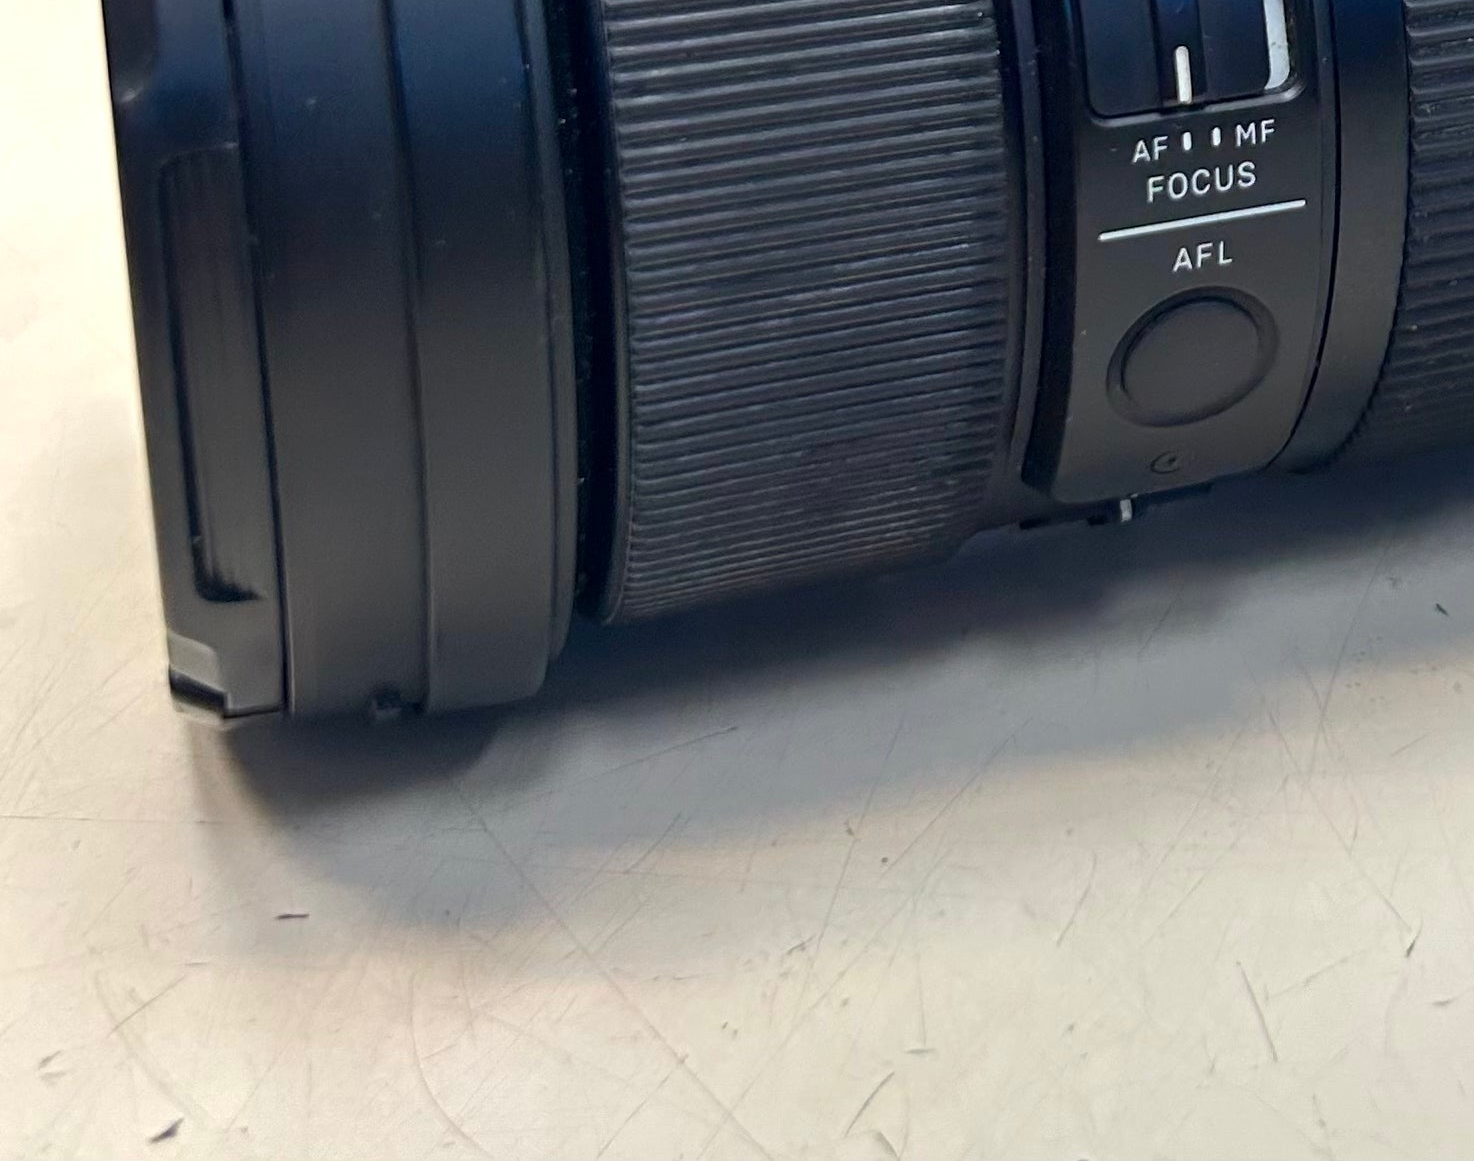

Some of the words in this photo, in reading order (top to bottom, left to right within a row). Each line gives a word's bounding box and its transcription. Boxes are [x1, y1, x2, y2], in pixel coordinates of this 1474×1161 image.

[1131, 135, 1168, 164] AF
[1235, 119, 1276, 147] MF
[1145, 160, 1257, 204] FOCUS
[1171, 240, 1234, 272] AFL
